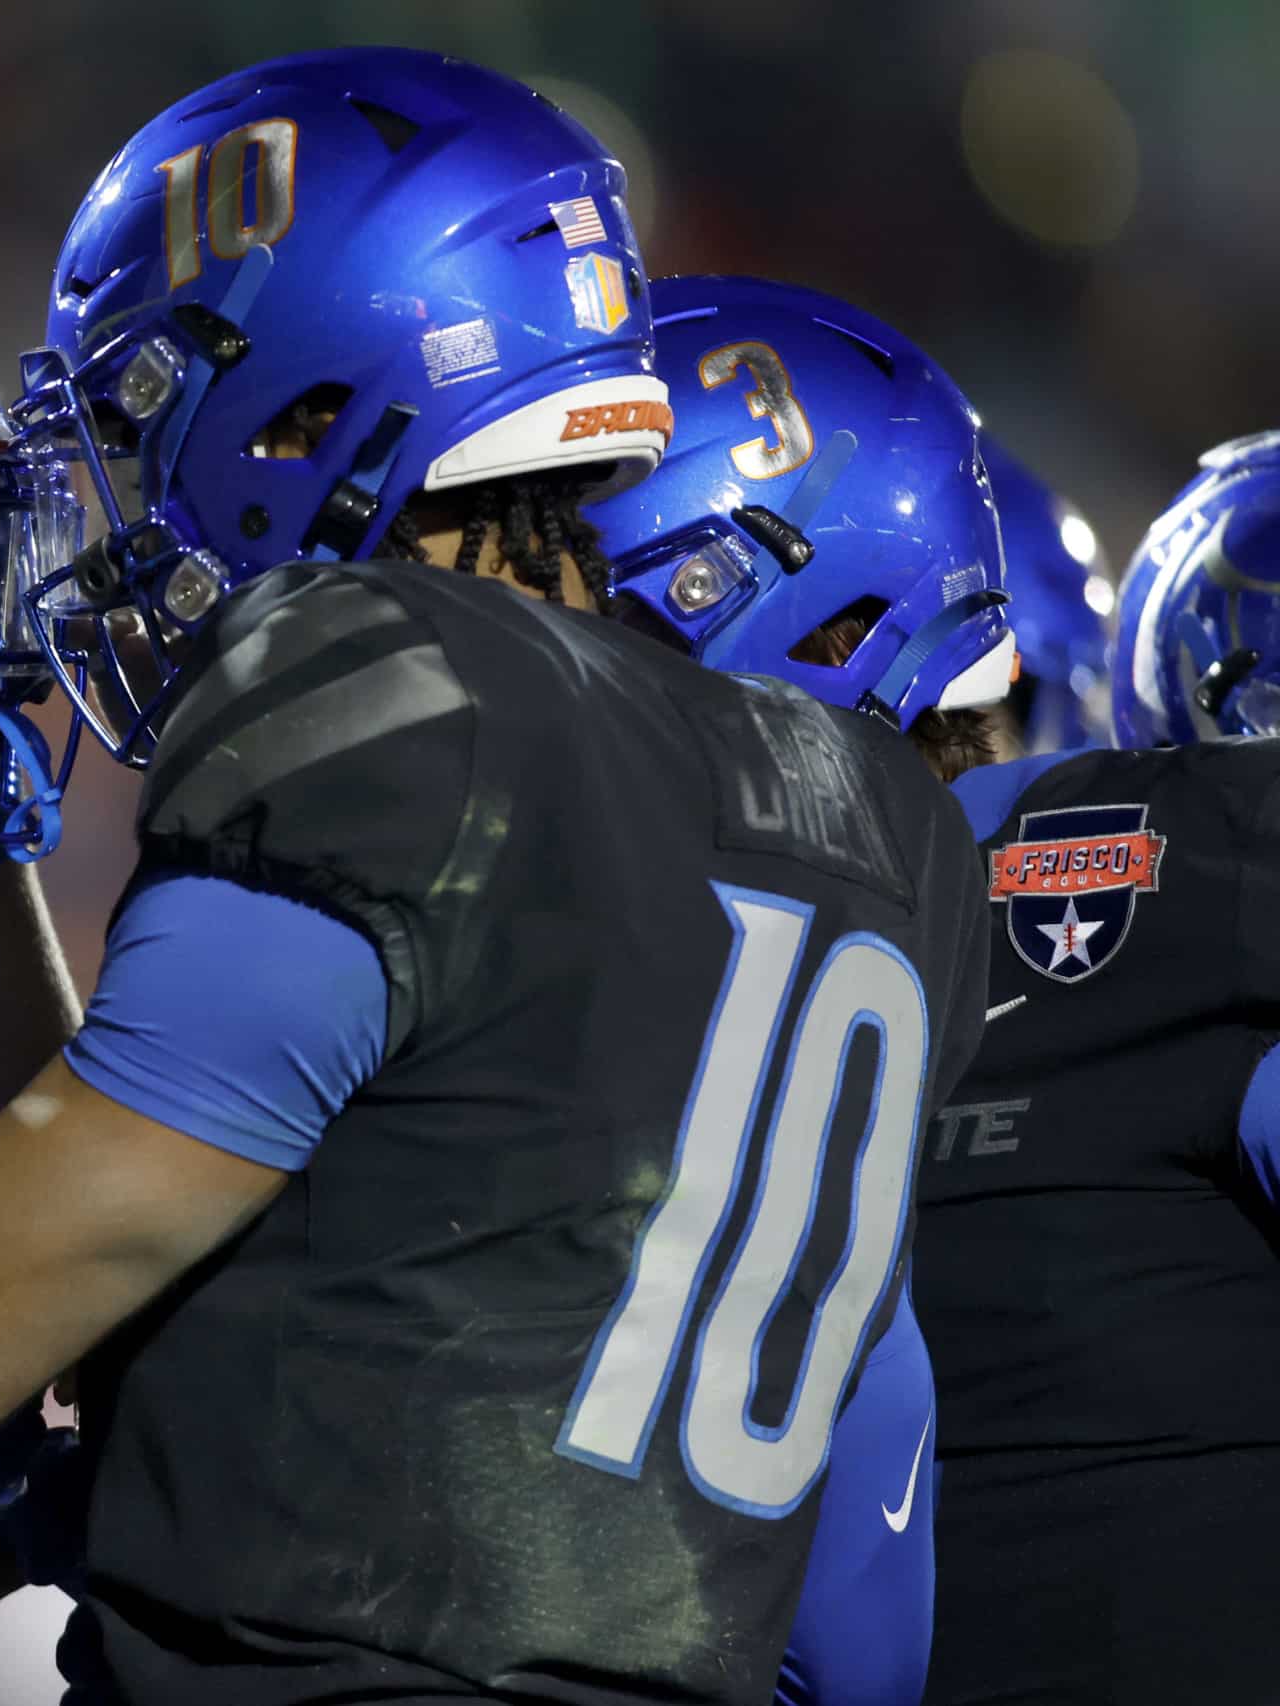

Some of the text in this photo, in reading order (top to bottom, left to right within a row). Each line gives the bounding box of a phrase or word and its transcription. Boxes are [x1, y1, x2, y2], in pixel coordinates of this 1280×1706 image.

[154, 117, 298, 291] 10
[698, 340, 815, 480] 3
[1018, 842, 1130, 884] FRISCO
[1042, 872, 1104, 888] BOWL
[937, 1098, 1032, 1161] TE
[552, 879, 928, 1520] 10
